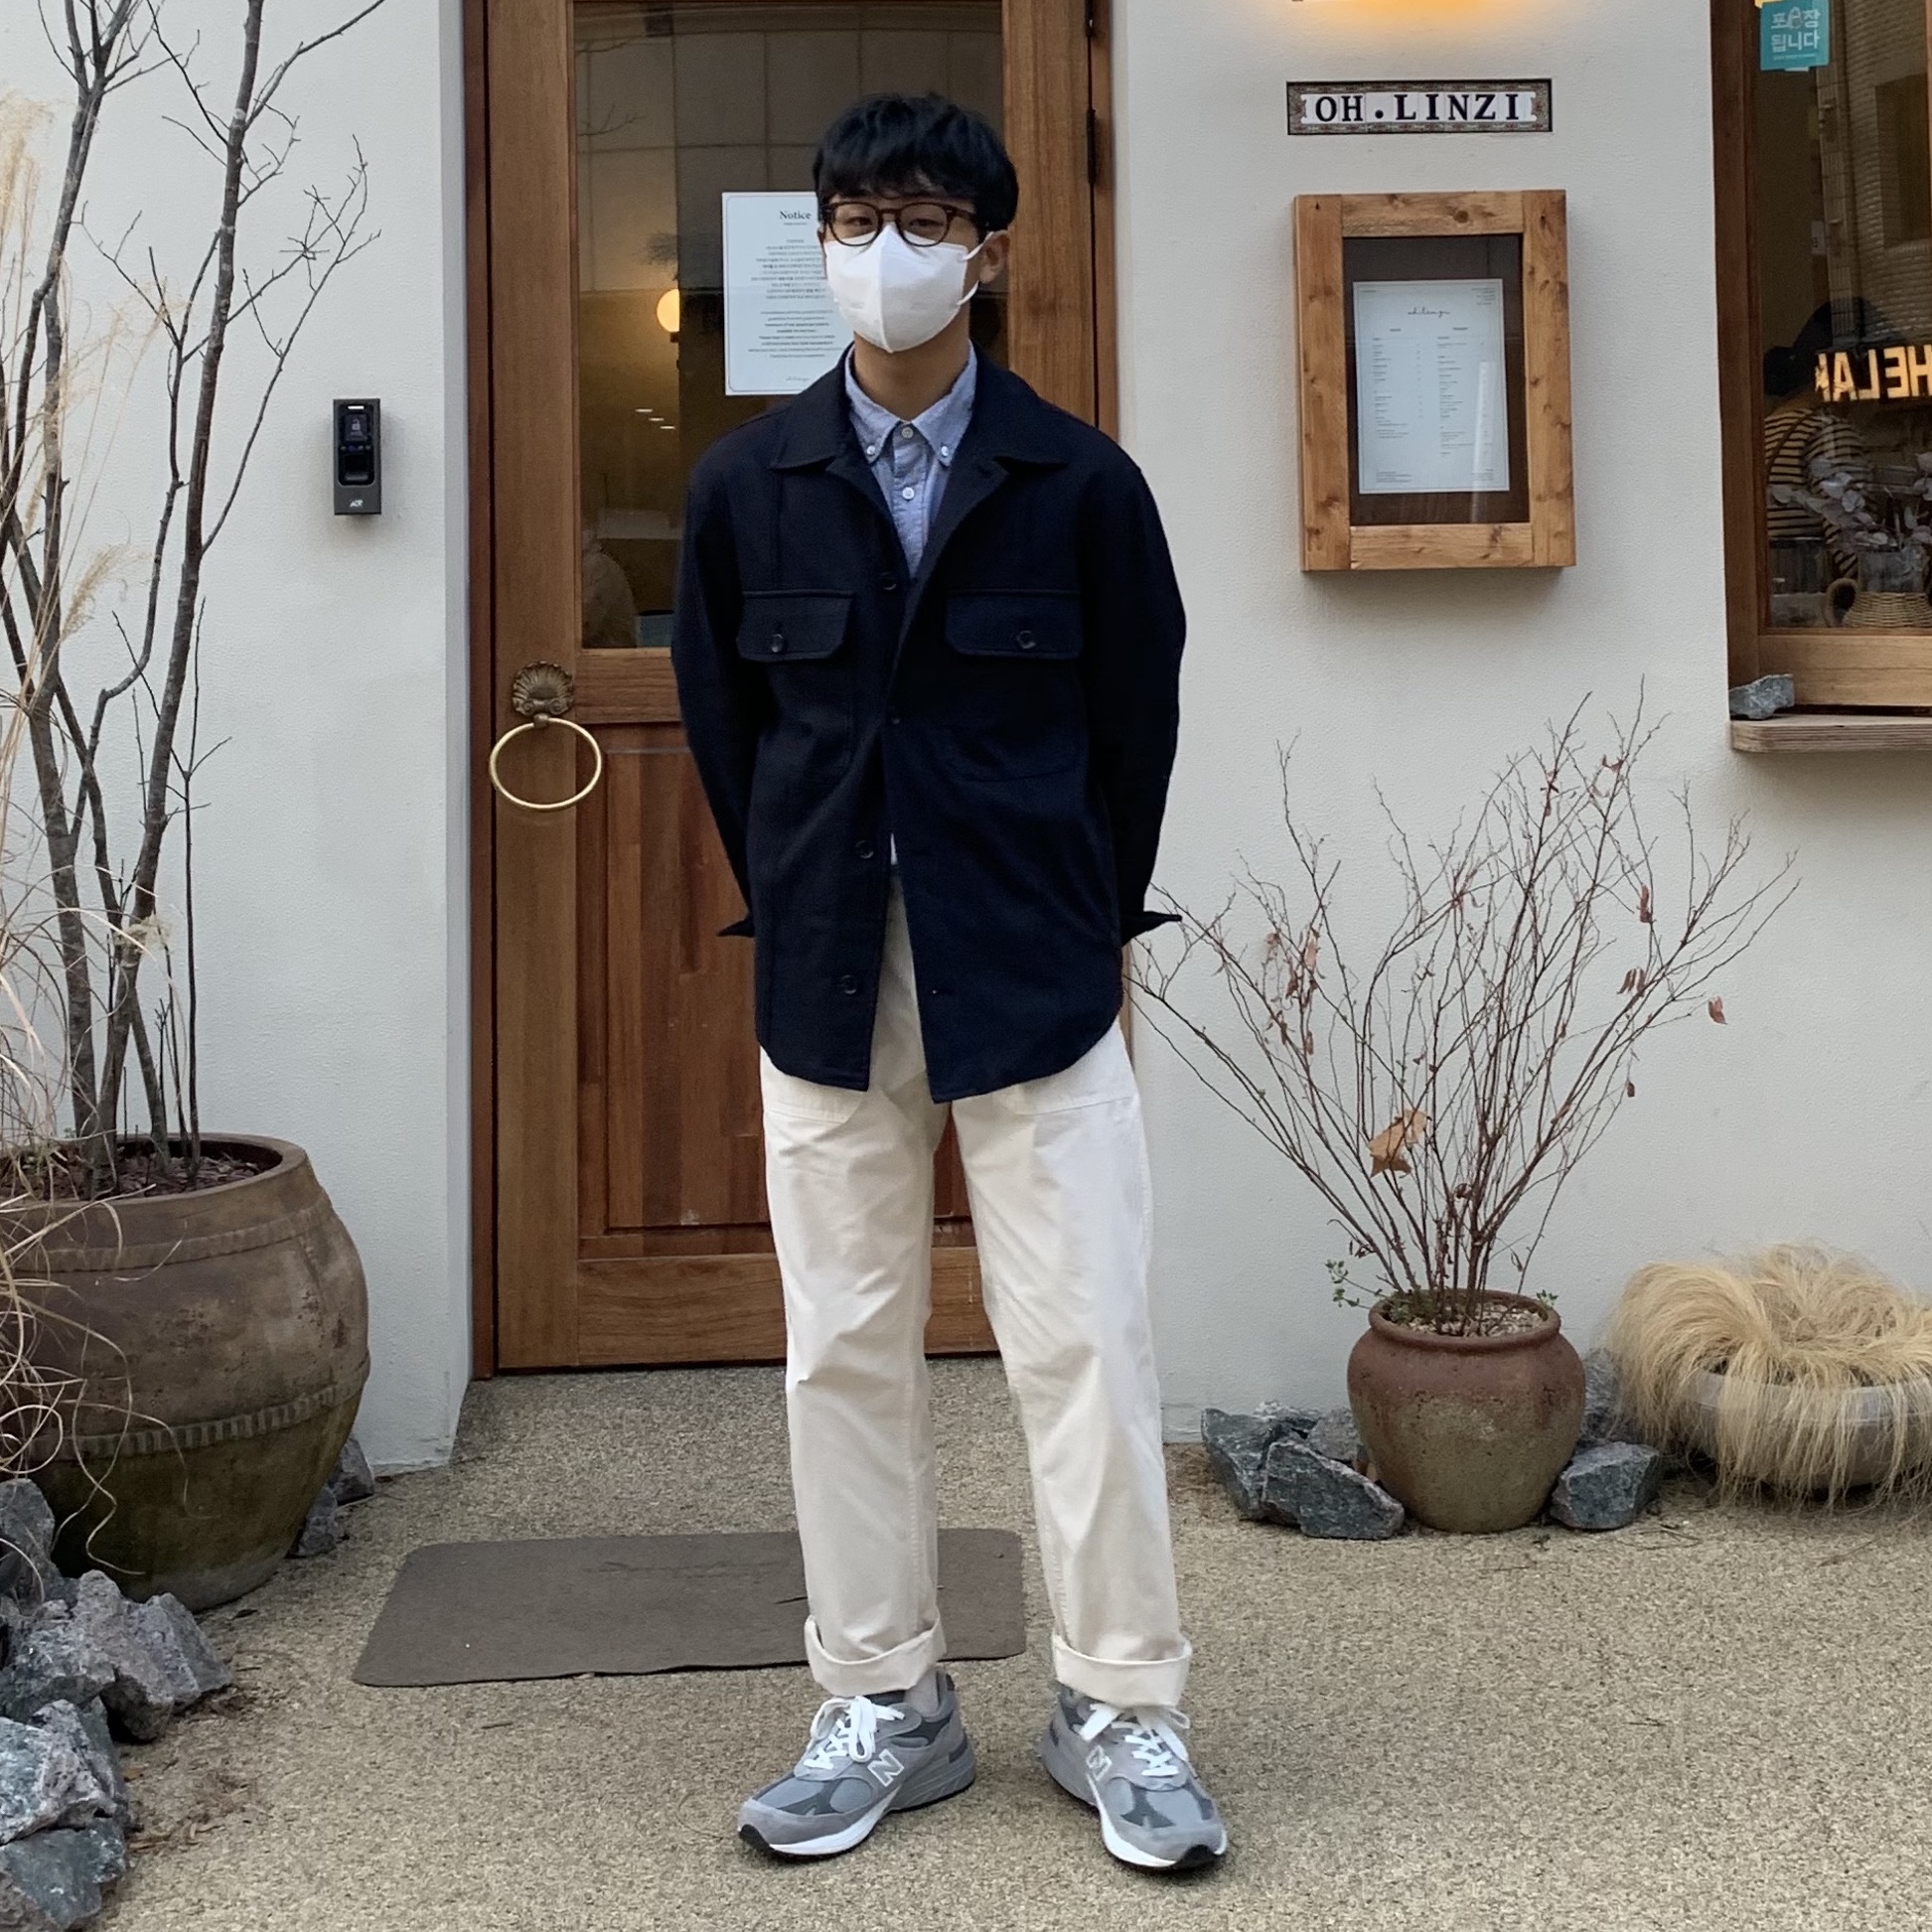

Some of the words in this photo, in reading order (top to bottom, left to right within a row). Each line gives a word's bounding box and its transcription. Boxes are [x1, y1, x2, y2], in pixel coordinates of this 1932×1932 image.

[1771, 8, 1821, 29] 포장
[1771, 29, 1821, 53] 됩니다
[779, 211, 813, 220] Notice
[867, 1748, 904, 1787] N
